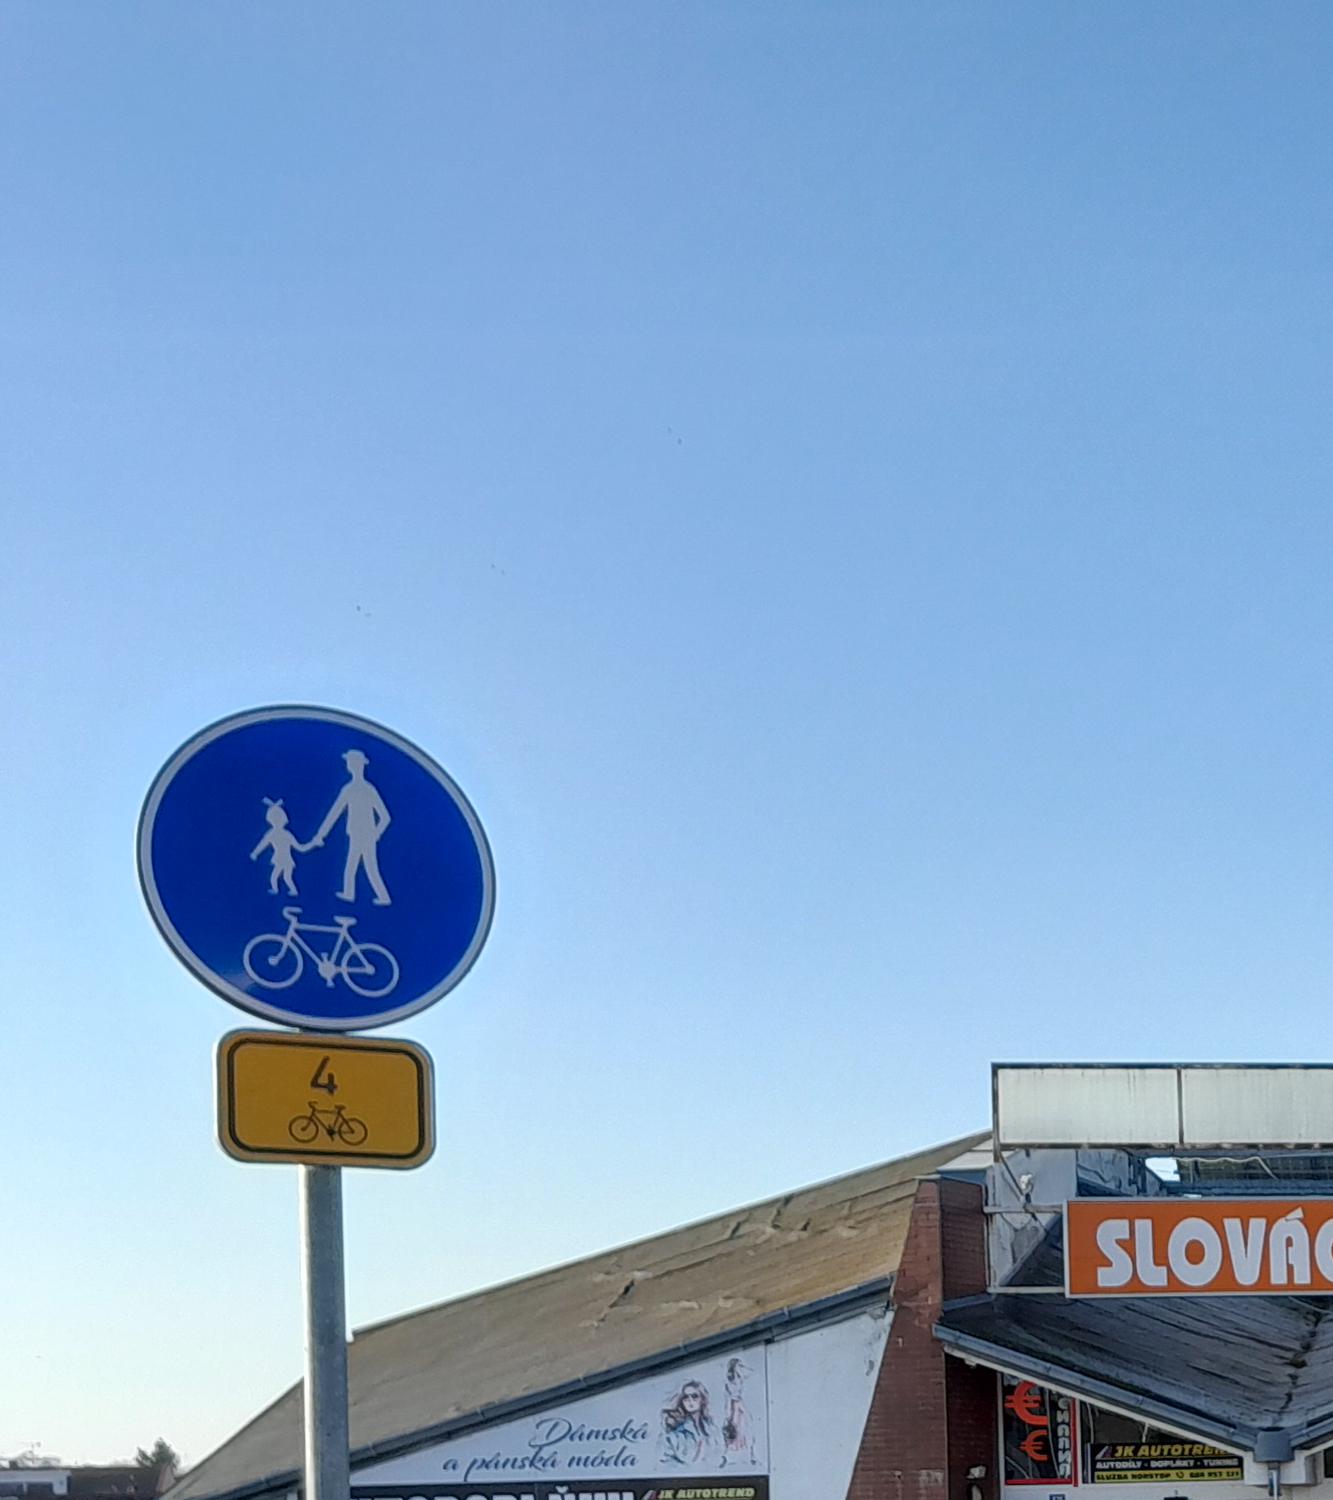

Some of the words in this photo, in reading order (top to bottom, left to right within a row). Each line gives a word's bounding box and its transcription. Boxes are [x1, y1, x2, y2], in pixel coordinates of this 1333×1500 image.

[310, 1056, 338, 1094] 4
[528, 1417, 649, 1448] Dámská
[442, 1457, 459, 1471] a
[463, 1446, 557, 1482] pánská
[567, 1446, 639, 1469] móda
[658, 1489, 674, 1499] JK
[676, 1487, 755, 1499] AUTOTREND
